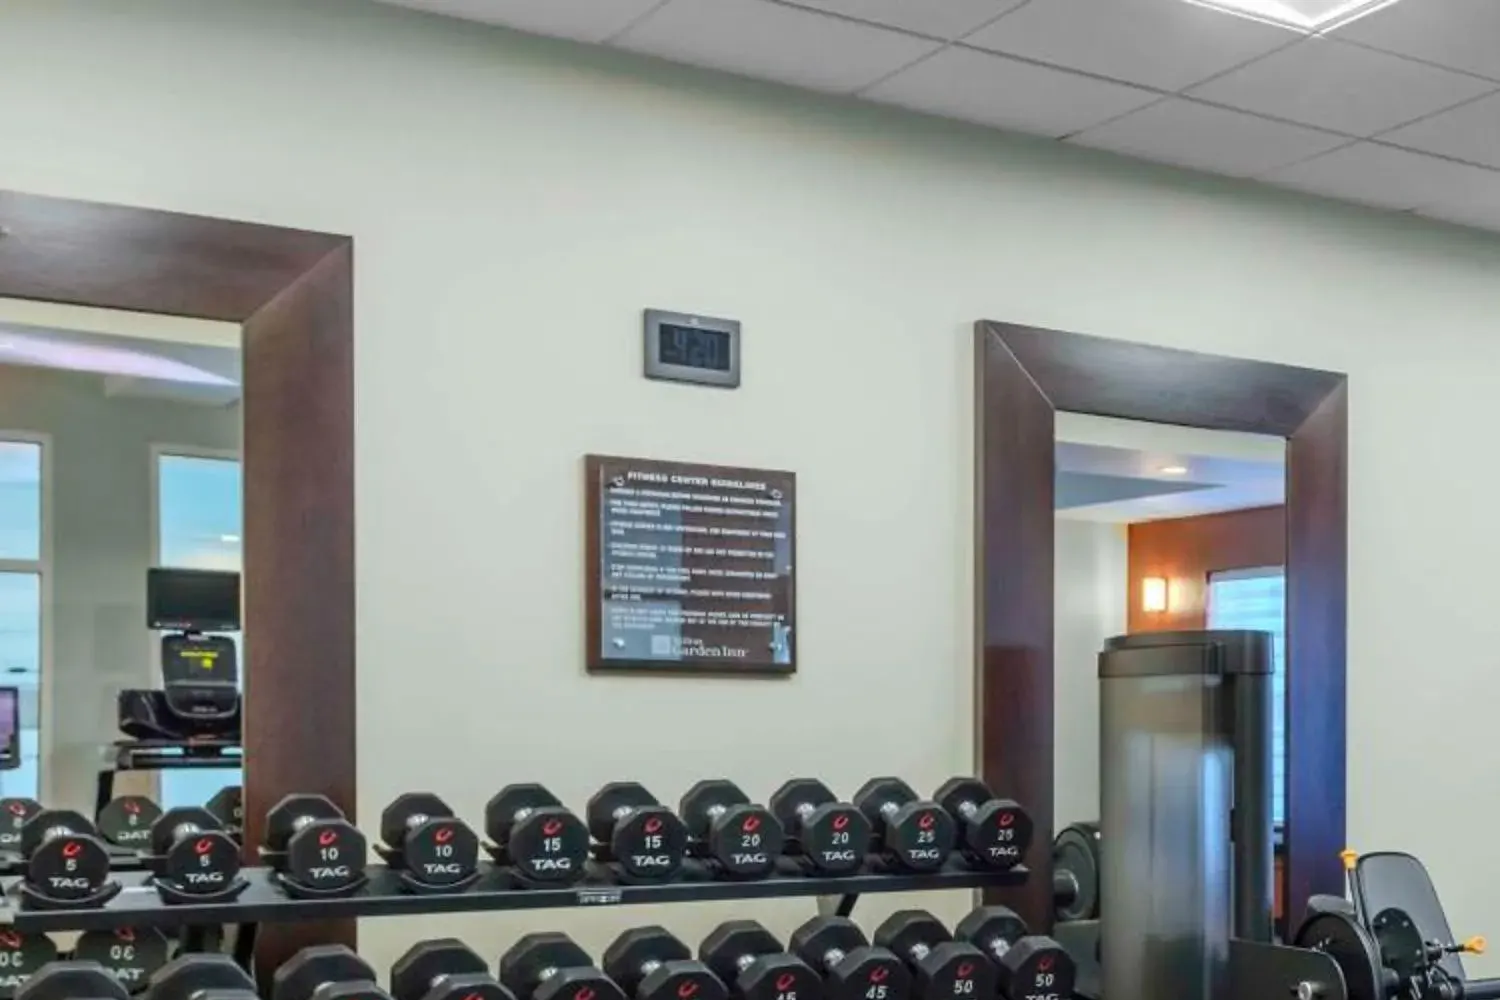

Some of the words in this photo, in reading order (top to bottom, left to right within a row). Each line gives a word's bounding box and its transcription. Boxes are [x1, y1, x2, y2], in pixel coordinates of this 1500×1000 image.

[645, 834, 663, 849] 15
[741, 833, 761, 847] 20
[831, 831, 849, 845] 20
[917, 829, 935, 844] 25
[997, 828, 1014, 841] 25
[435, 844, 453, 858] 10
[543, 837, 561, 852] 15
[988, 845, 1019, 857] TAG
[320, 847, 339, 861] 10
[632, 855, 670, 867] TAG
[732, 852, 767, 865] TAG
[822, 849, 855, 862] TAG
[908, 849, 940, 859] TAG
[65, 858, 77, 872] 5
[423, 863, 461, 874] TAG
[531, 857, 571, 871] TAG
[185, 871, 224, 884] TAG
[309, 865, 350, 879] TAG
[48, 877, 89, 889] TAG
[953, 979, 973, 995] 50
[1035, 973, 1055, 988] 50
[865, 985, 888, 1000] 45
